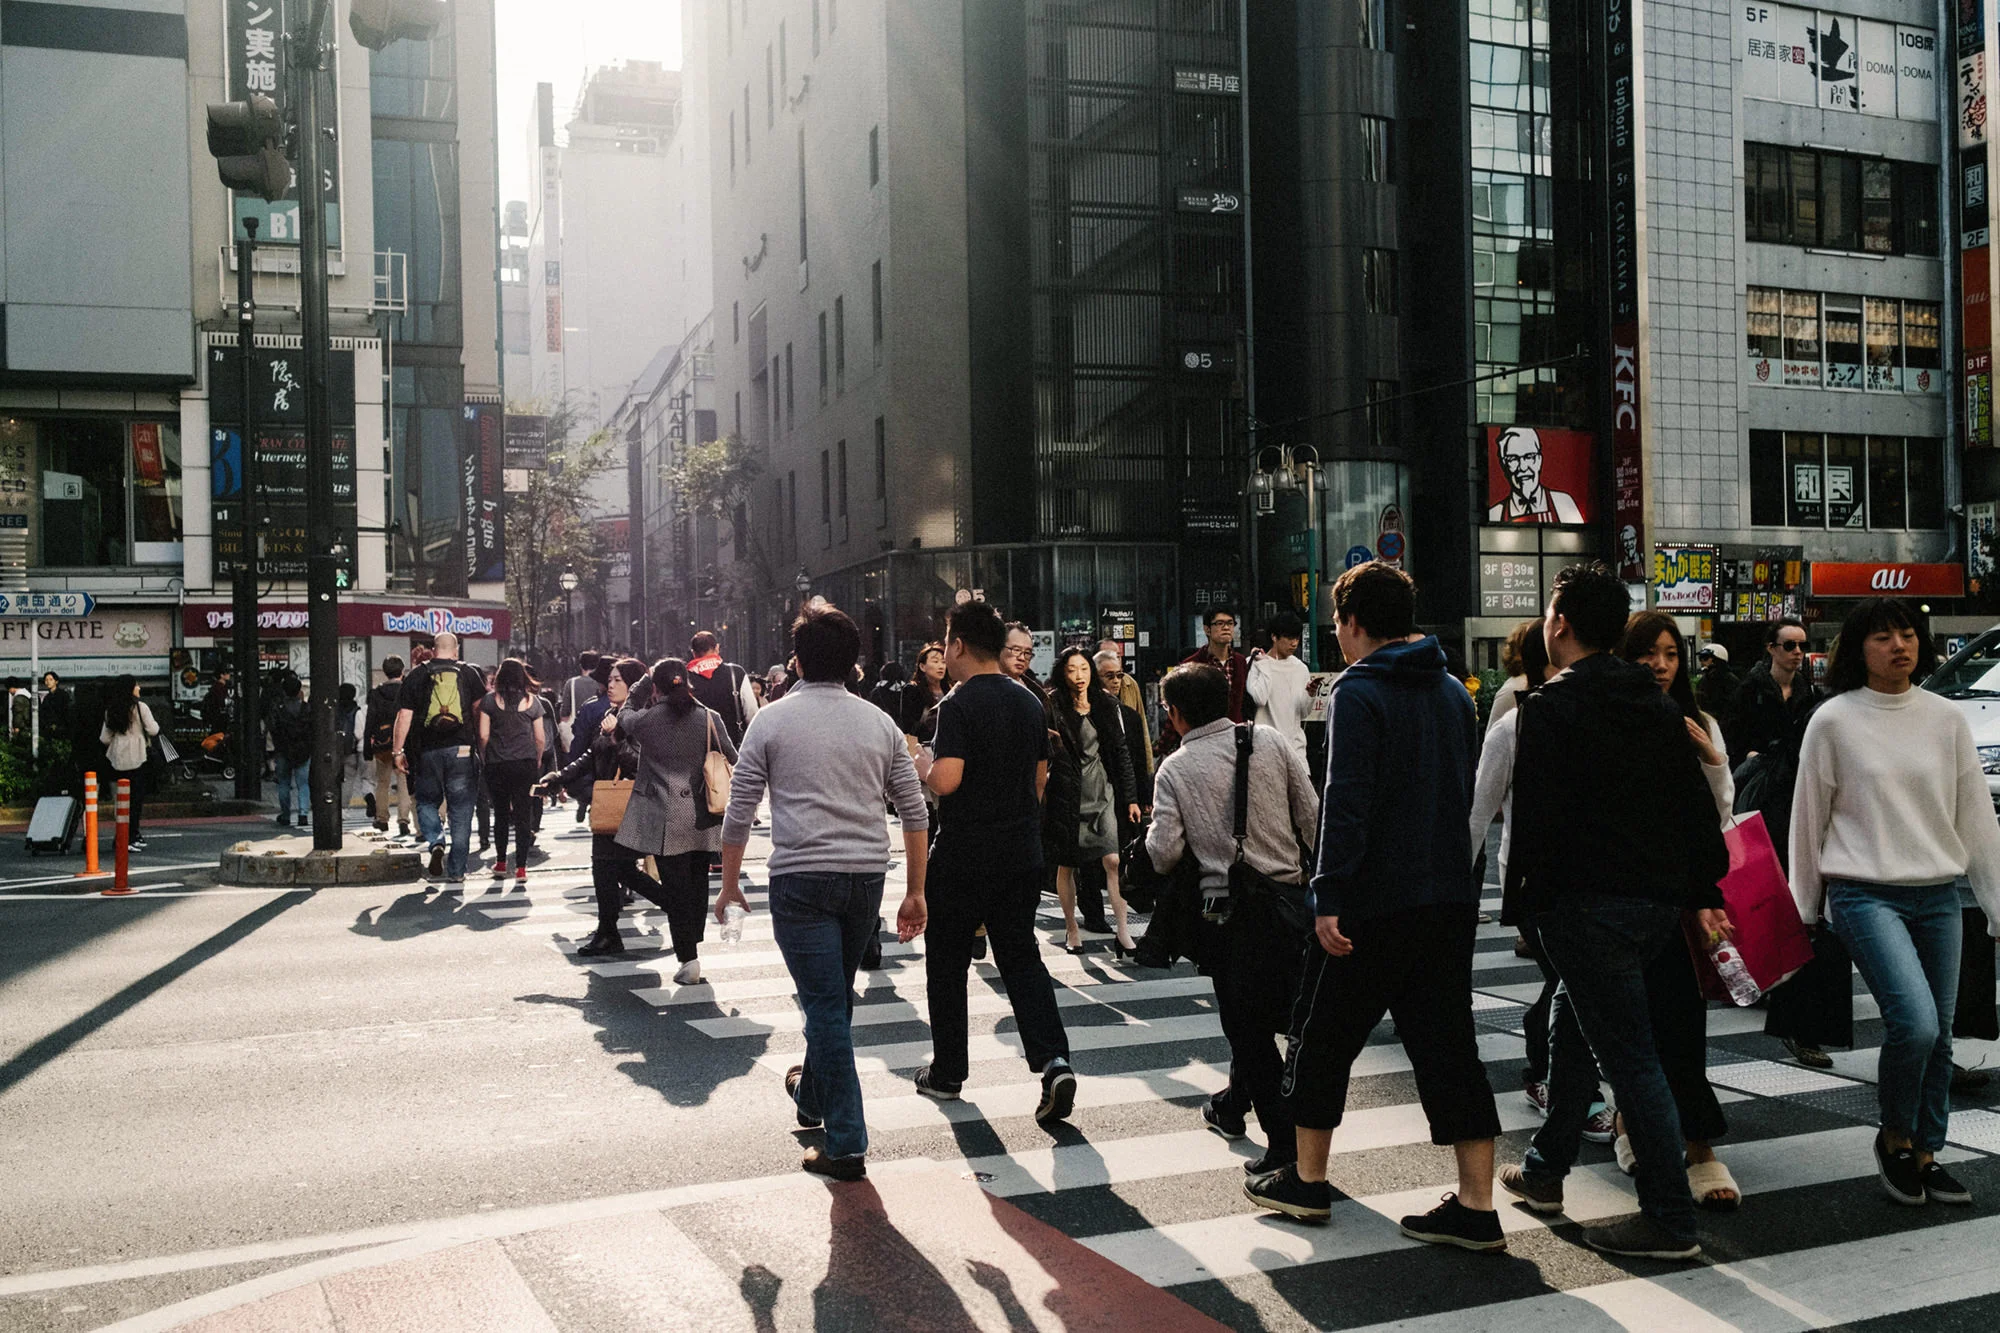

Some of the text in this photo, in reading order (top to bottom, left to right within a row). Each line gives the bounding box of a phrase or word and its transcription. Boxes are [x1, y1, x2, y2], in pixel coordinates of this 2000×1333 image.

[1746, 7, 1768, 23] 5F
[246, 1, 276, 104] ン実施
[1208, 73, 1240, 92] 角座
[1614, 75, 1629, 147] Euphoria
[1966, 168, 1982, 205] 和民
[1967, 231, 1984, 247] 2F
[1966, 291, 1986, 305] au
[1968, 356, 1988, 369] B1F
[1615, 344, 1636, 430] KFC
[1797, 466, 1851, 502] 和民
[1852, 515, 1863, 525] 2F
[1484, 564, 1498, 575] 3F
[1654, 553, 1712, 585] まんが喫茶
[1871, 569, 1911, 590] au
[16, 595, 77, 607] 靖国通り
[1485, 596, 1499, 607] 2F
[37, 620, 104, 640] GATE
[388, 613, 428, 632] baskin
[455, 617, 493, 635] robbins
[259, 660, 289, 671] ゴルフ
